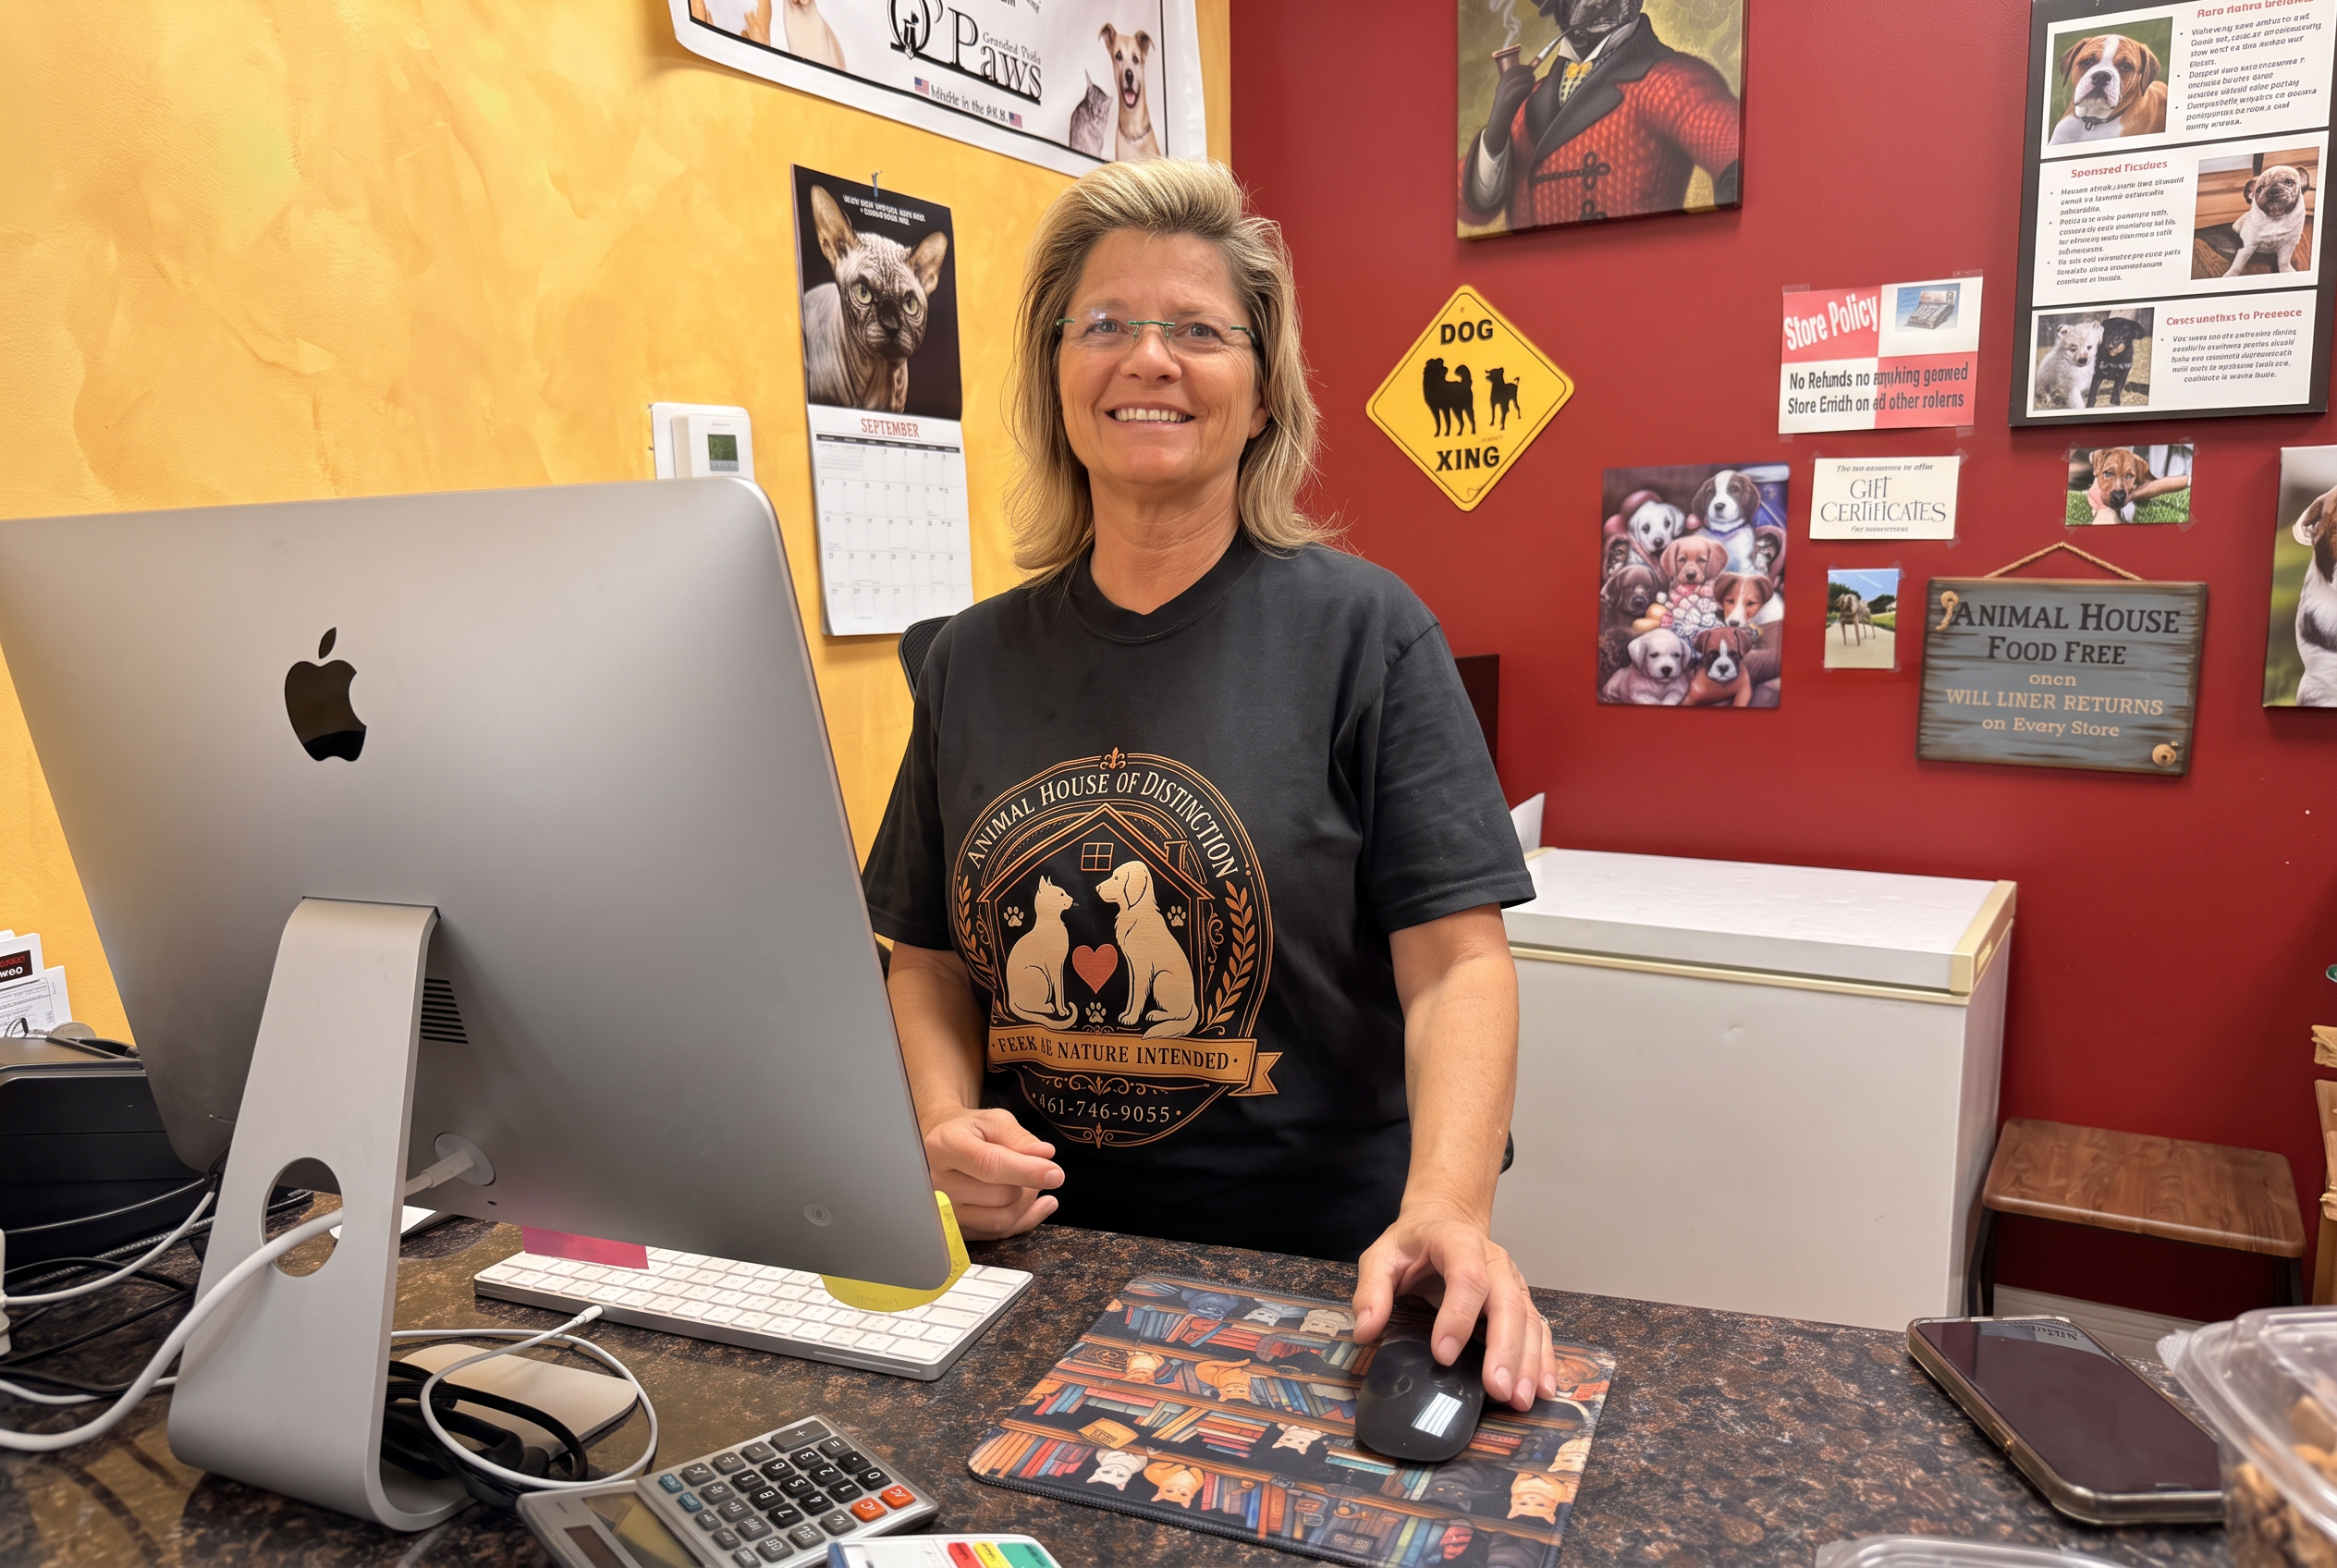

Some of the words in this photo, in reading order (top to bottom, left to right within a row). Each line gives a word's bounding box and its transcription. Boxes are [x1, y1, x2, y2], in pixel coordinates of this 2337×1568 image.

[1440, 319, 1494, 347] DOG
[1783, 312, 1829, 351] Store
[1828, 292, 1878, 337] Policy
[1790, 373, 1805, 390] No
[1856, 373, 1870, 386] no
[1788, 397, 1817, 414] Store
[1855, 398, 1869, 411] on
[1889, 392, 1920, 410] other
[861, 418, 920, 438] SEPTEMBER
[1435, 446, 1500, 472] XING
[1952, 601, 2068, 629] ANIMAL
[2078, 603, 2181, 633] HOUSE
[1987, 635, 2057, 662] FOOD
[2063, 642, 2126, 665] FREE
[2029, 674, 2076, 686] oncn
[1946, 689, 1990, 706] WILL
[1997, 691, 2056, 710] LINER
[2063, 695, 2163, 716] RETURNS
[1982, 717, 2005, 730] on
[2013, 717, 2066, 737] Every
[2071, 721, 2120, 738] Store
[967, 797, 1035, 870] ANIMAL
[1039, 773, 1109, 807] HOUSE
[1116, 771, 1141, 794] OF
[1140, 770, 1239, 879] DISTINCTION
[1058, 1041, 1129, 1064] NATURE
[1136, 1047, 1229, 1071] INTENDED
